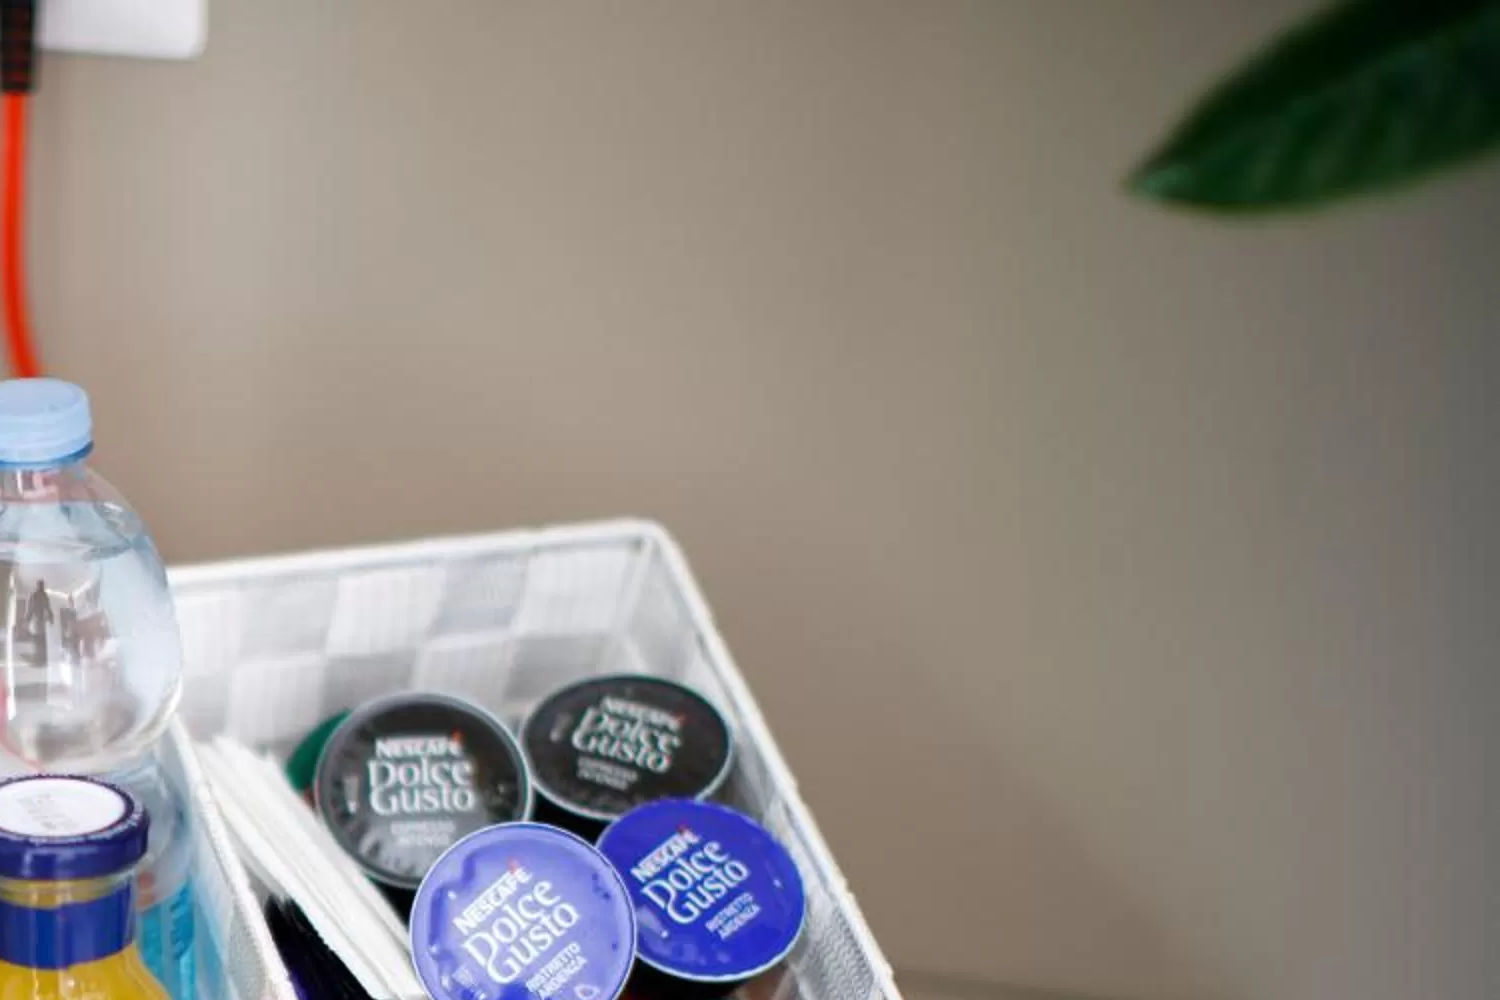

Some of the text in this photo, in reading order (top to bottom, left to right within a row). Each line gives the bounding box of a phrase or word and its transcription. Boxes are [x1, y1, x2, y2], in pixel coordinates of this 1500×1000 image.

[368, 756, 473, 788] Dolce
[572, 728, 671, 773] Gusto
[369, 783, 477, 815] Gusto
[641, 842, 729, 909] Dolce
[668, 860, 749, 924] Gusto
[461, 881, 560, 967] Dolce
[487, 903, 580, 984] Gusto
